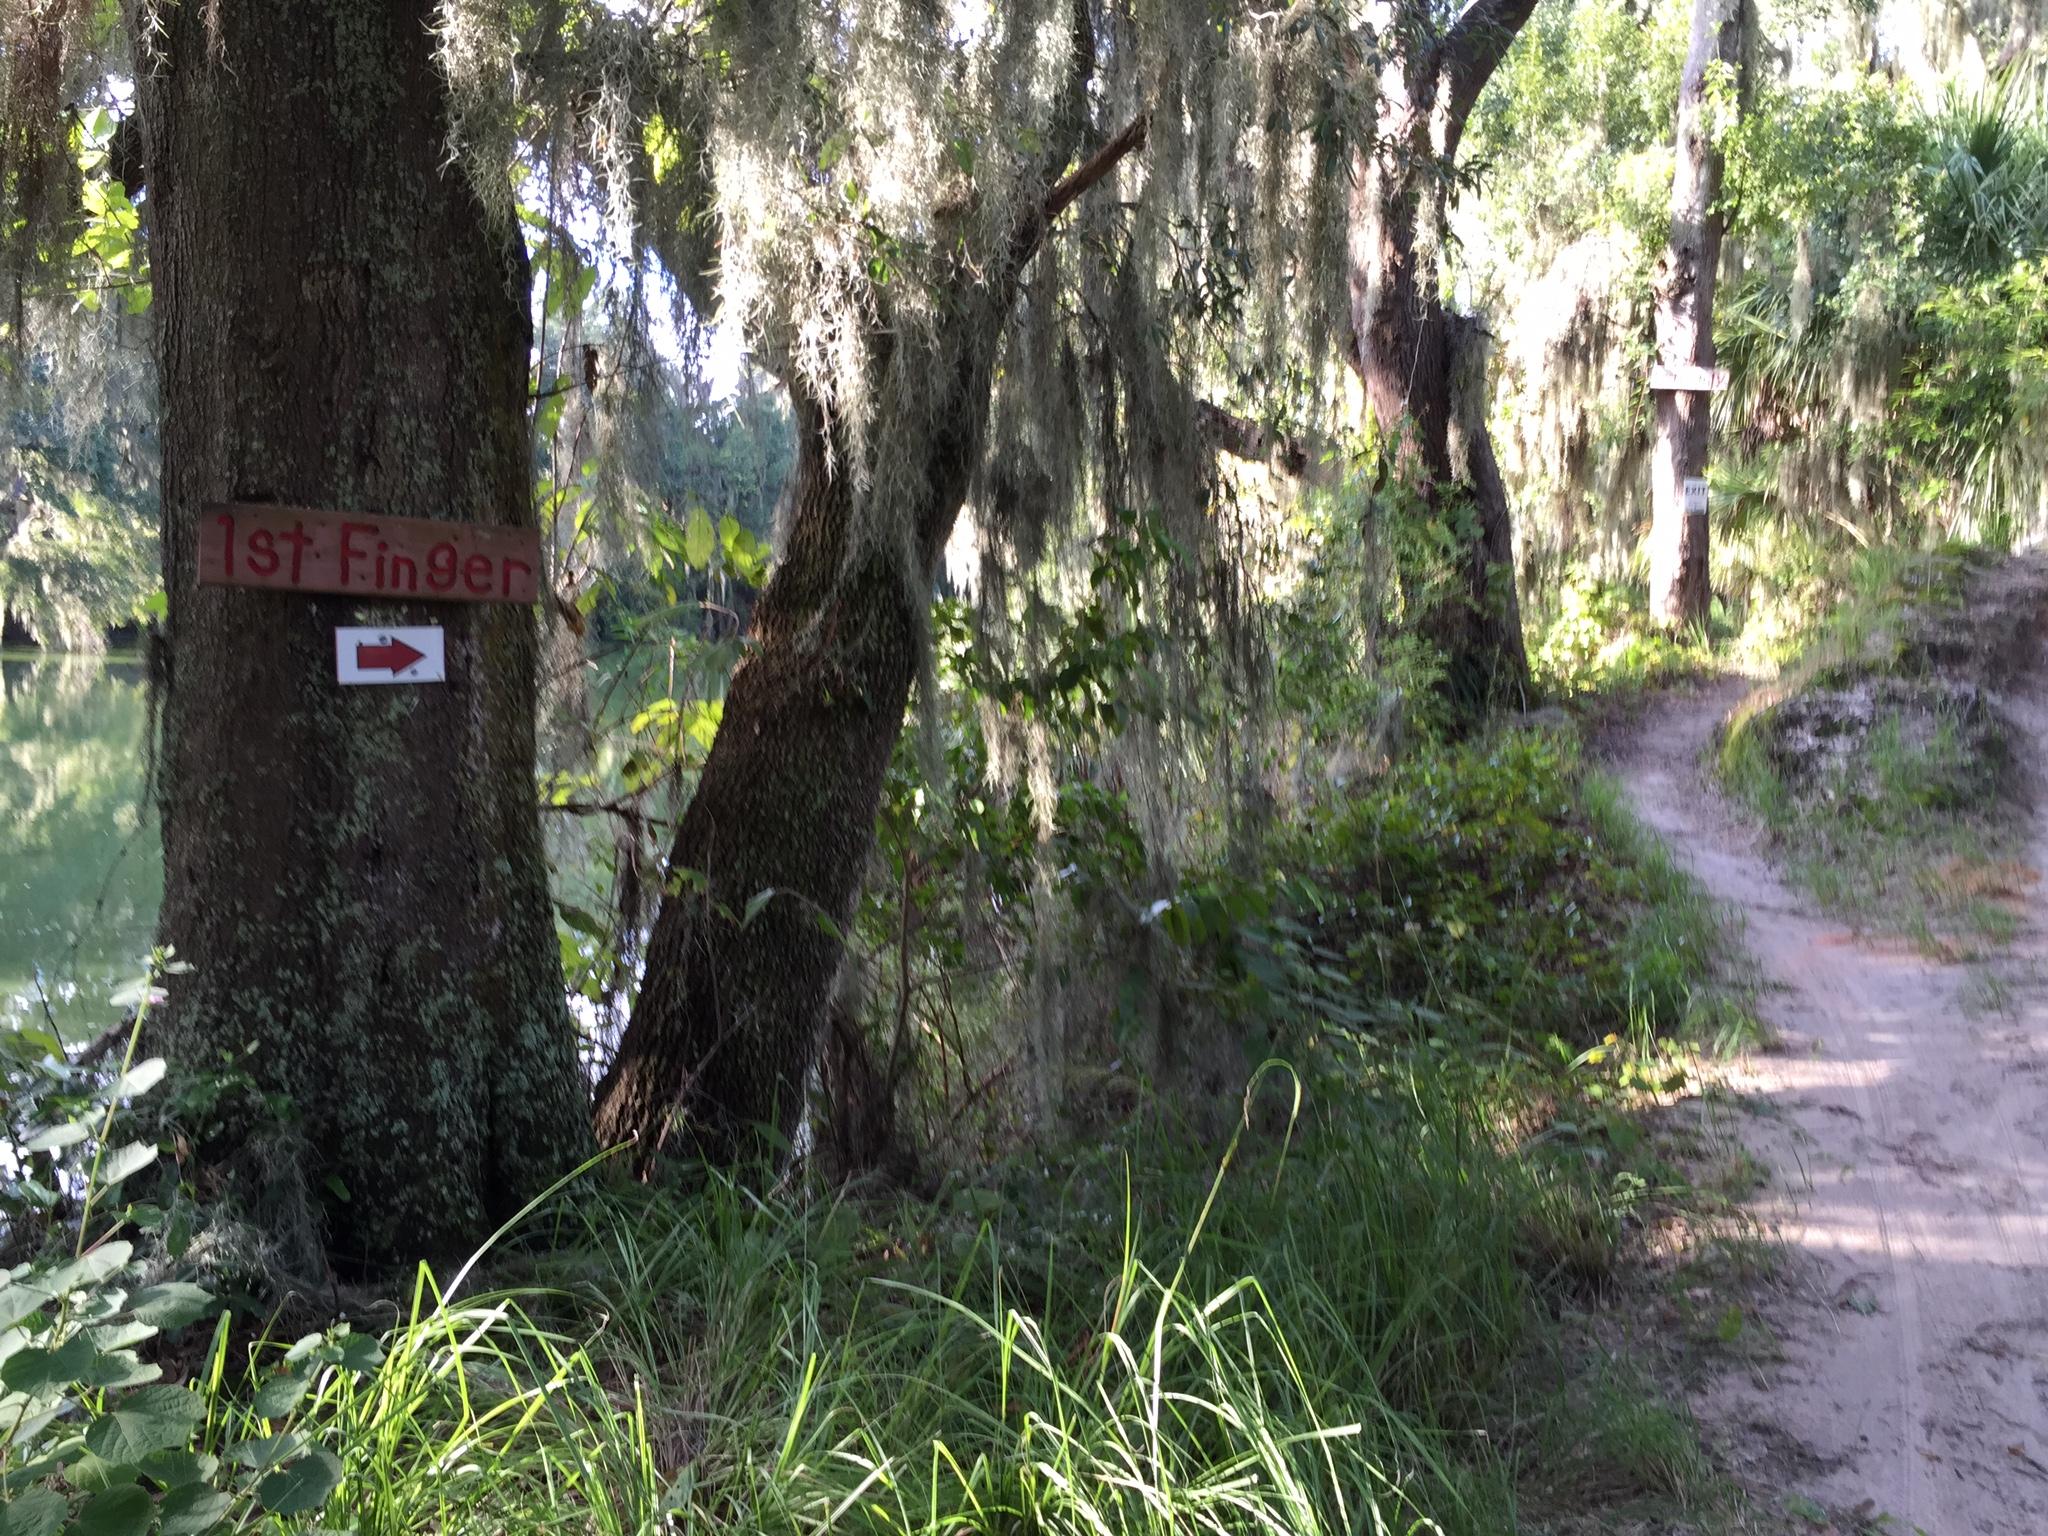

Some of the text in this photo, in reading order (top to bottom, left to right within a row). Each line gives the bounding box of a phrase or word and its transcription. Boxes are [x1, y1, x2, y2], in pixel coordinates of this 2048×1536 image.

[1685, 486, 1706, 496] EXIT
[217, 513, 533, 598] 1st Finger
